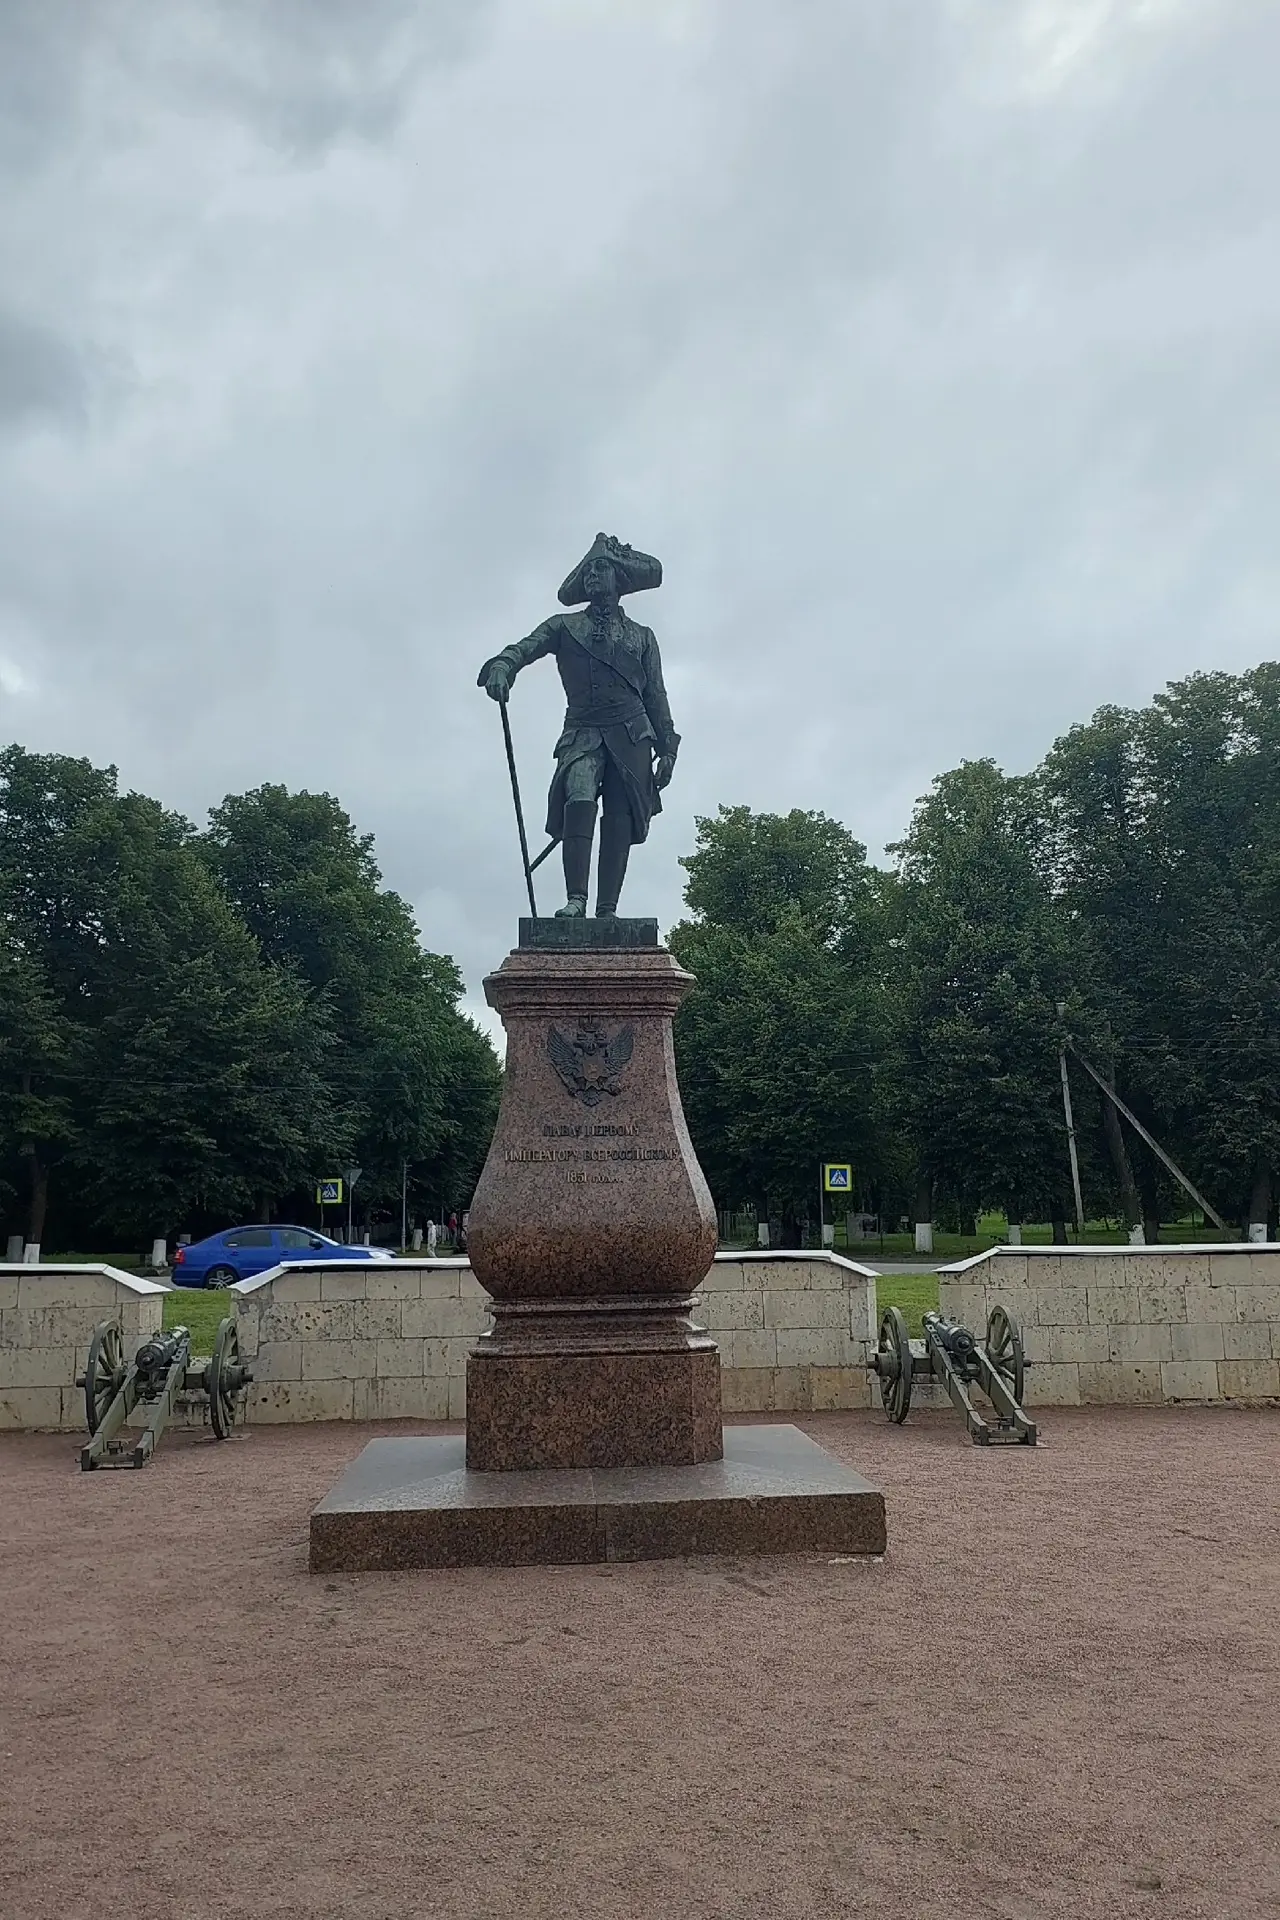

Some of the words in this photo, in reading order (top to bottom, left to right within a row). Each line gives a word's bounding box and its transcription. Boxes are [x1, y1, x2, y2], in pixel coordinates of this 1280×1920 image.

[543, 1125, 580, 1137] ПАВЛУ
[584, 1125, 639, 1137] ПЕРВОМУ
[505, 1149, 578, 1161] ИМПЕРАТОРУ
[567, 1171, 587, 1183] 1851
